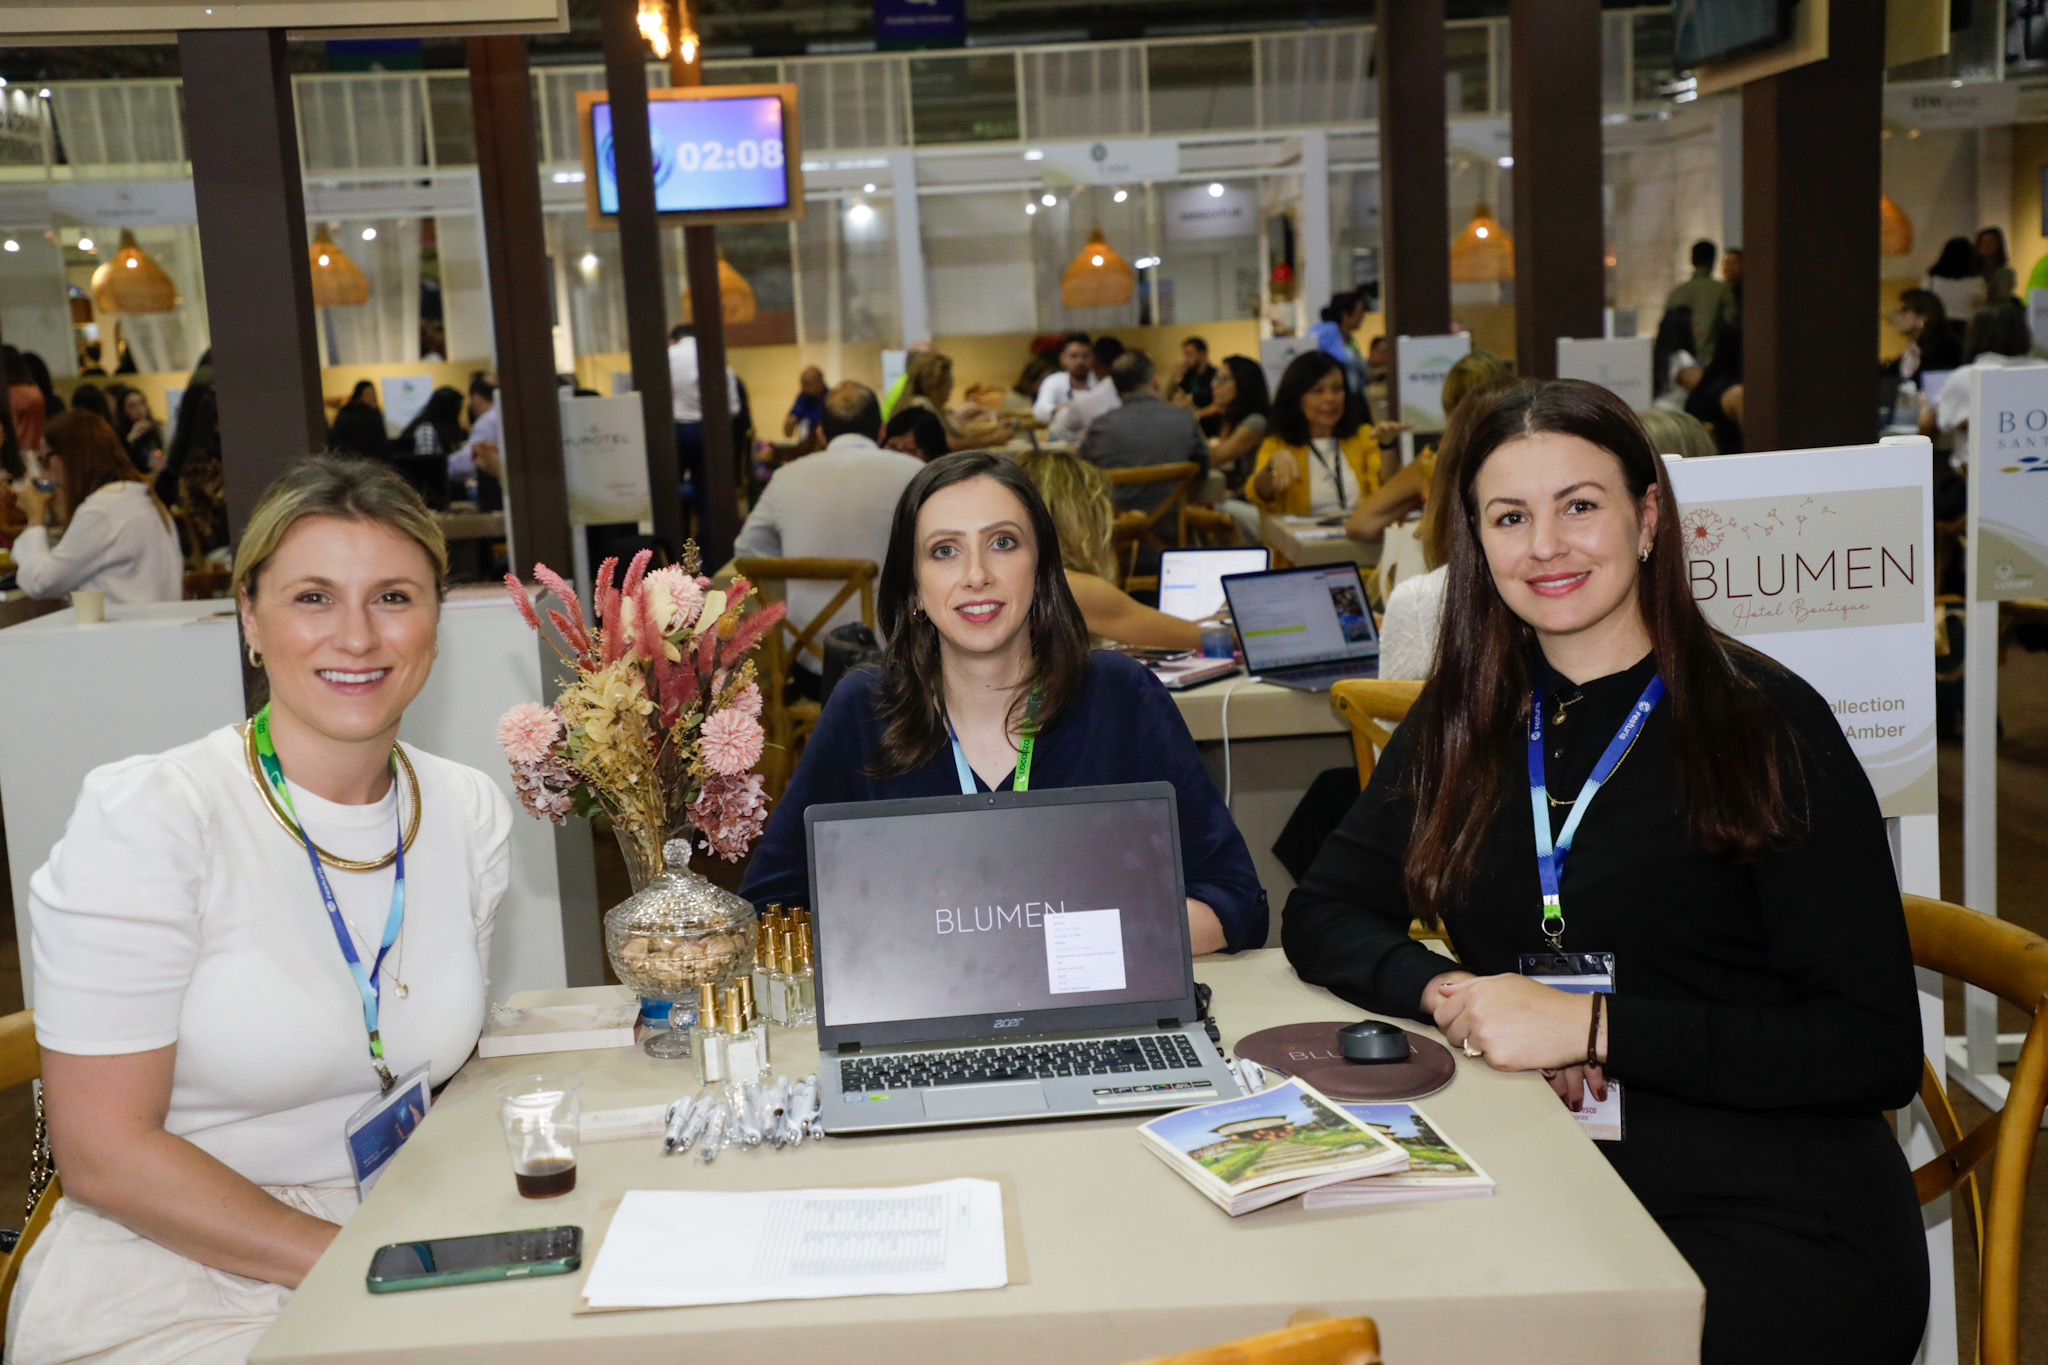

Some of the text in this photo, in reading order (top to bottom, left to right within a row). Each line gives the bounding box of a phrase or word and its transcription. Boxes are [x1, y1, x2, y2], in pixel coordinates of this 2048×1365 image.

[677, 138, 785, 172] 02:08
[1689, 544, 1914, 601] BLUMEN
[1732, 597, 1871, 629] Hotel Boutique
[1829, 697, 1906, 714] ollection
[1618, 710, 1642, 740] Festuris
[1845, 723, 1906, 740] Amber
[1018, 739, 1030, 775] Locaiza
[935, 900, 1065, 934] BLUMEN
[993, 1017, 1025, 1029] acer
